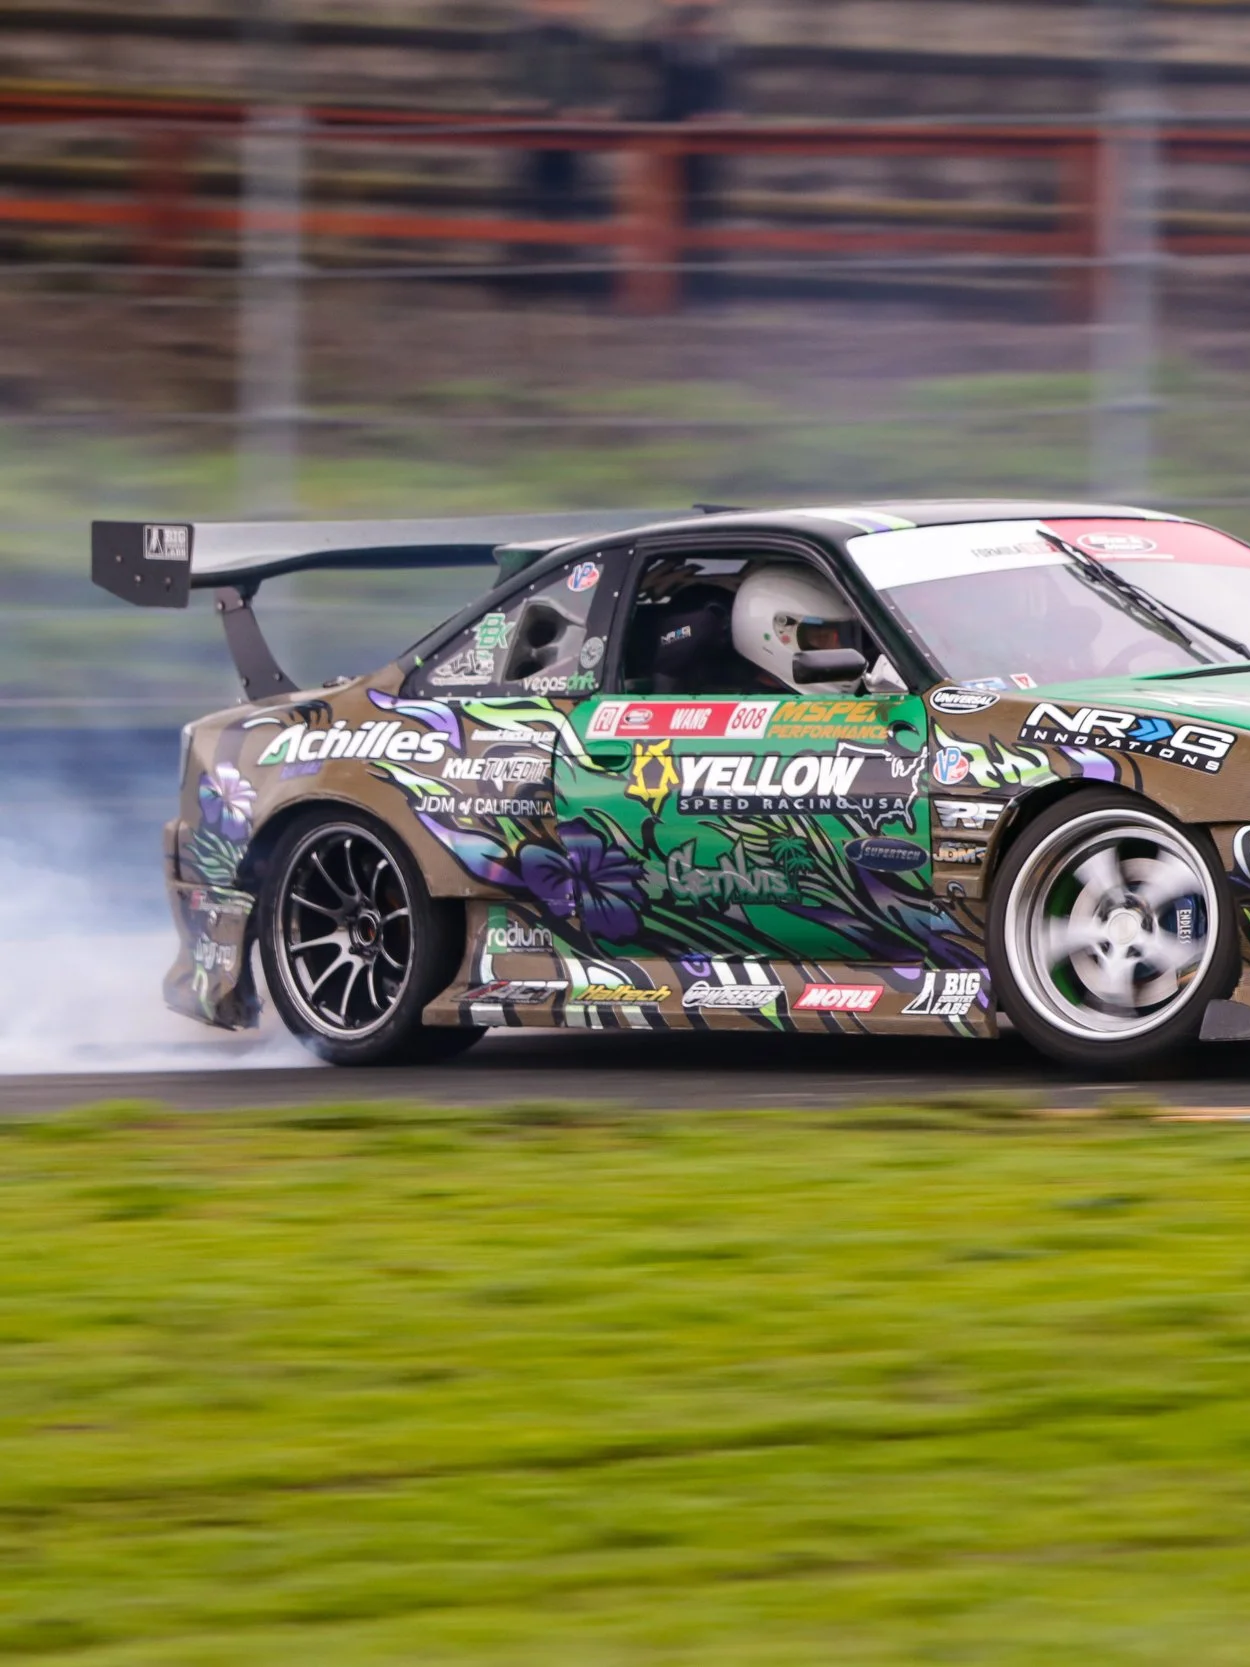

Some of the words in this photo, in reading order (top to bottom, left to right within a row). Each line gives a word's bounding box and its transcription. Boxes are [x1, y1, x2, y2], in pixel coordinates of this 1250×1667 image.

[934, 692, 993, 705] UNIVERSAL
[670, 708, 712, 730] WANG
[731, 707, 768, 730] 808
[257, 720, 450, 765] Achilles
[767, 724, 888, 740] PERFORMANCE
[1020, 727, 1221, 772] INNOVATIONS
[680, 756, 865, 796] YELLOW
[415, 796, 456, 813] JDM
[475, 798, 554, 817] CALIFORNIA
[680, 798, 749, 810] SPEED
[763, 798, 848, 810] RACING
[862, 797, 905, 810] USA
[864, 847, 921, 860] SUPERTECH
[933, 847, 976, 863] JDM
[487, 921, 553, 947] radium
[1179, 909, 1192, 945] ENDLESS
[575, 984, 673, 1001] Haltech
[942, 973, 981, 996] BIG
[798, 988, 877, 1009] MOTUL
[930, 1003, 972, 1015] LABS
